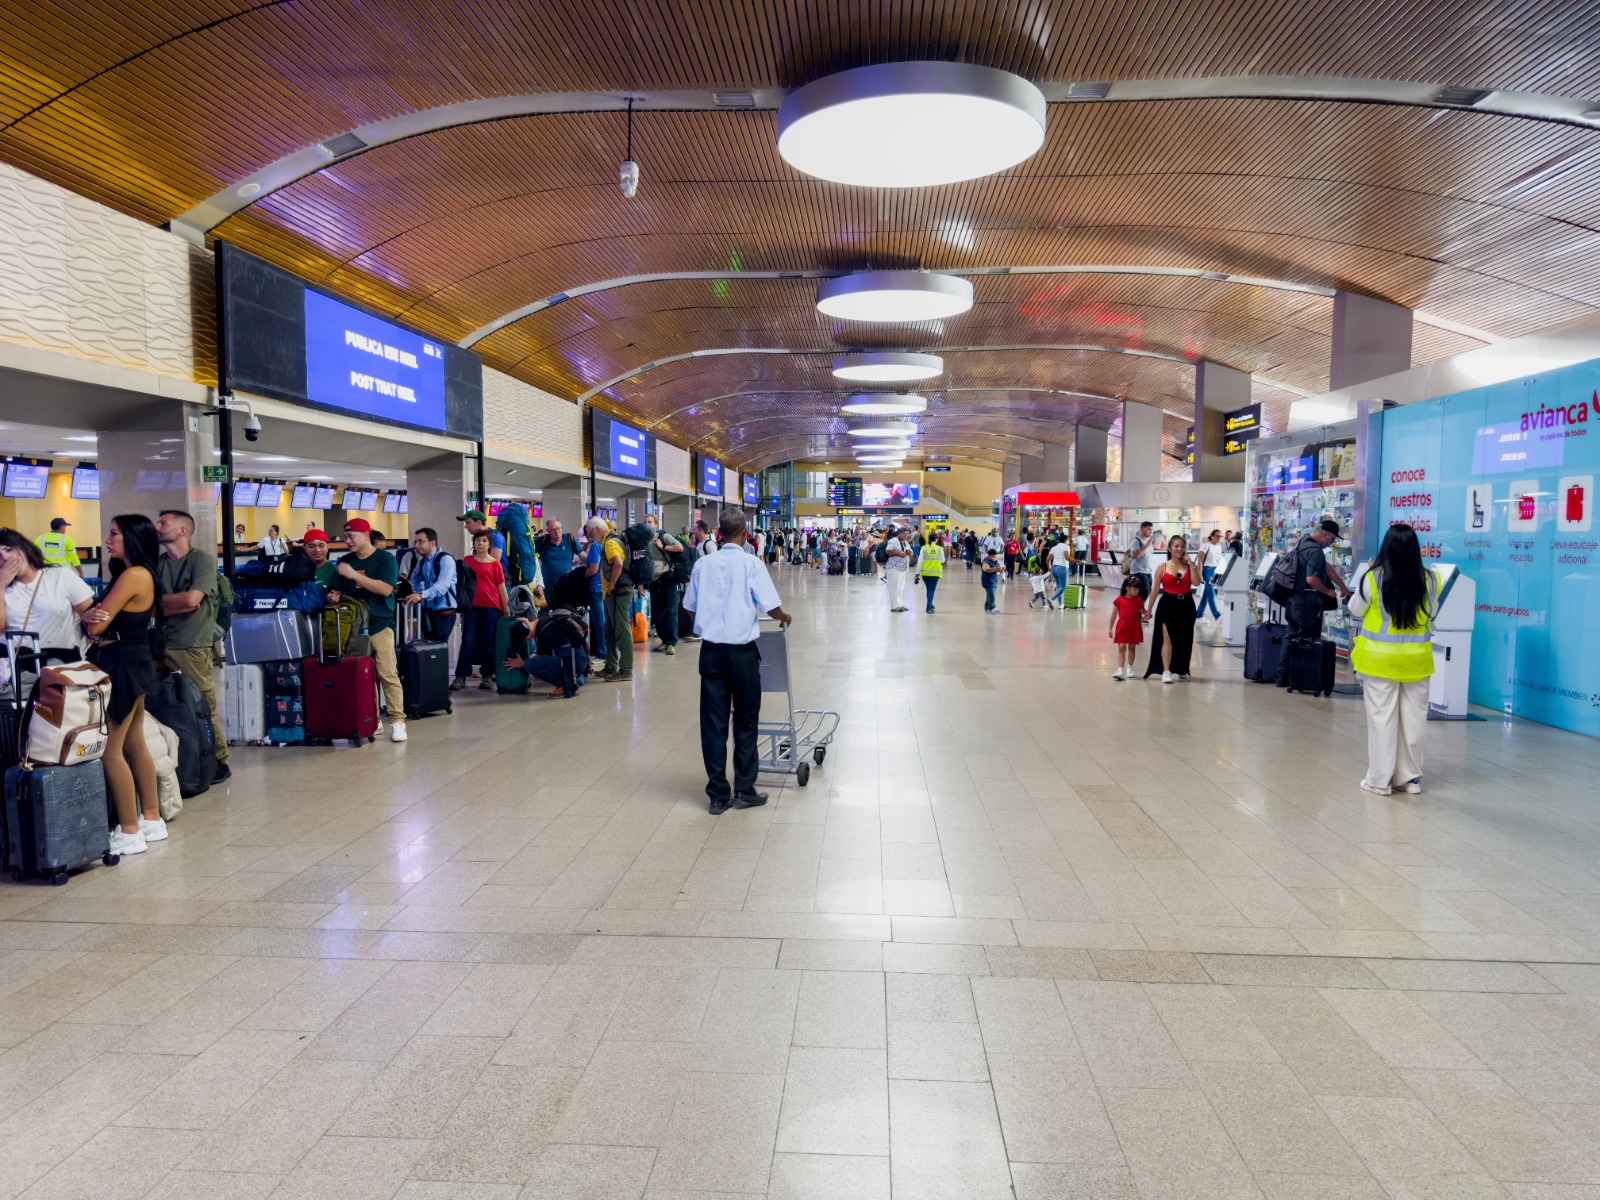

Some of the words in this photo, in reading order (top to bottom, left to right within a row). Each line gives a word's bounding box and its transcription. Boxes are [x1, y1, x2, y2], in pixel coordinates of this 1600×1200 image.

[345, 330, 383, 357] PUBLICA
[350, 371, 374, 391] POST
[375, 378, 397, 397] THAT
[1520, 403, 1588, 432] avianca
[1564, 429, 1571, 438] de
[1571, 427, 1588, 436] todos
[1391, 468, 1425, 484] conoce
[1390, 492, 1432, 508] nuestros
[1568, 539, 1598, 552] equipaje
[1508, 553, 1534, 563] mascota
[1557, 554, 1588, 565] adicional
[1493, 606, 1507, 614] para
[1507, 607, 1530, 616] grupos
[1528, 683, 1557, 694] ALLIANCE
[1558, 688, 1588, 701] MEMBER
